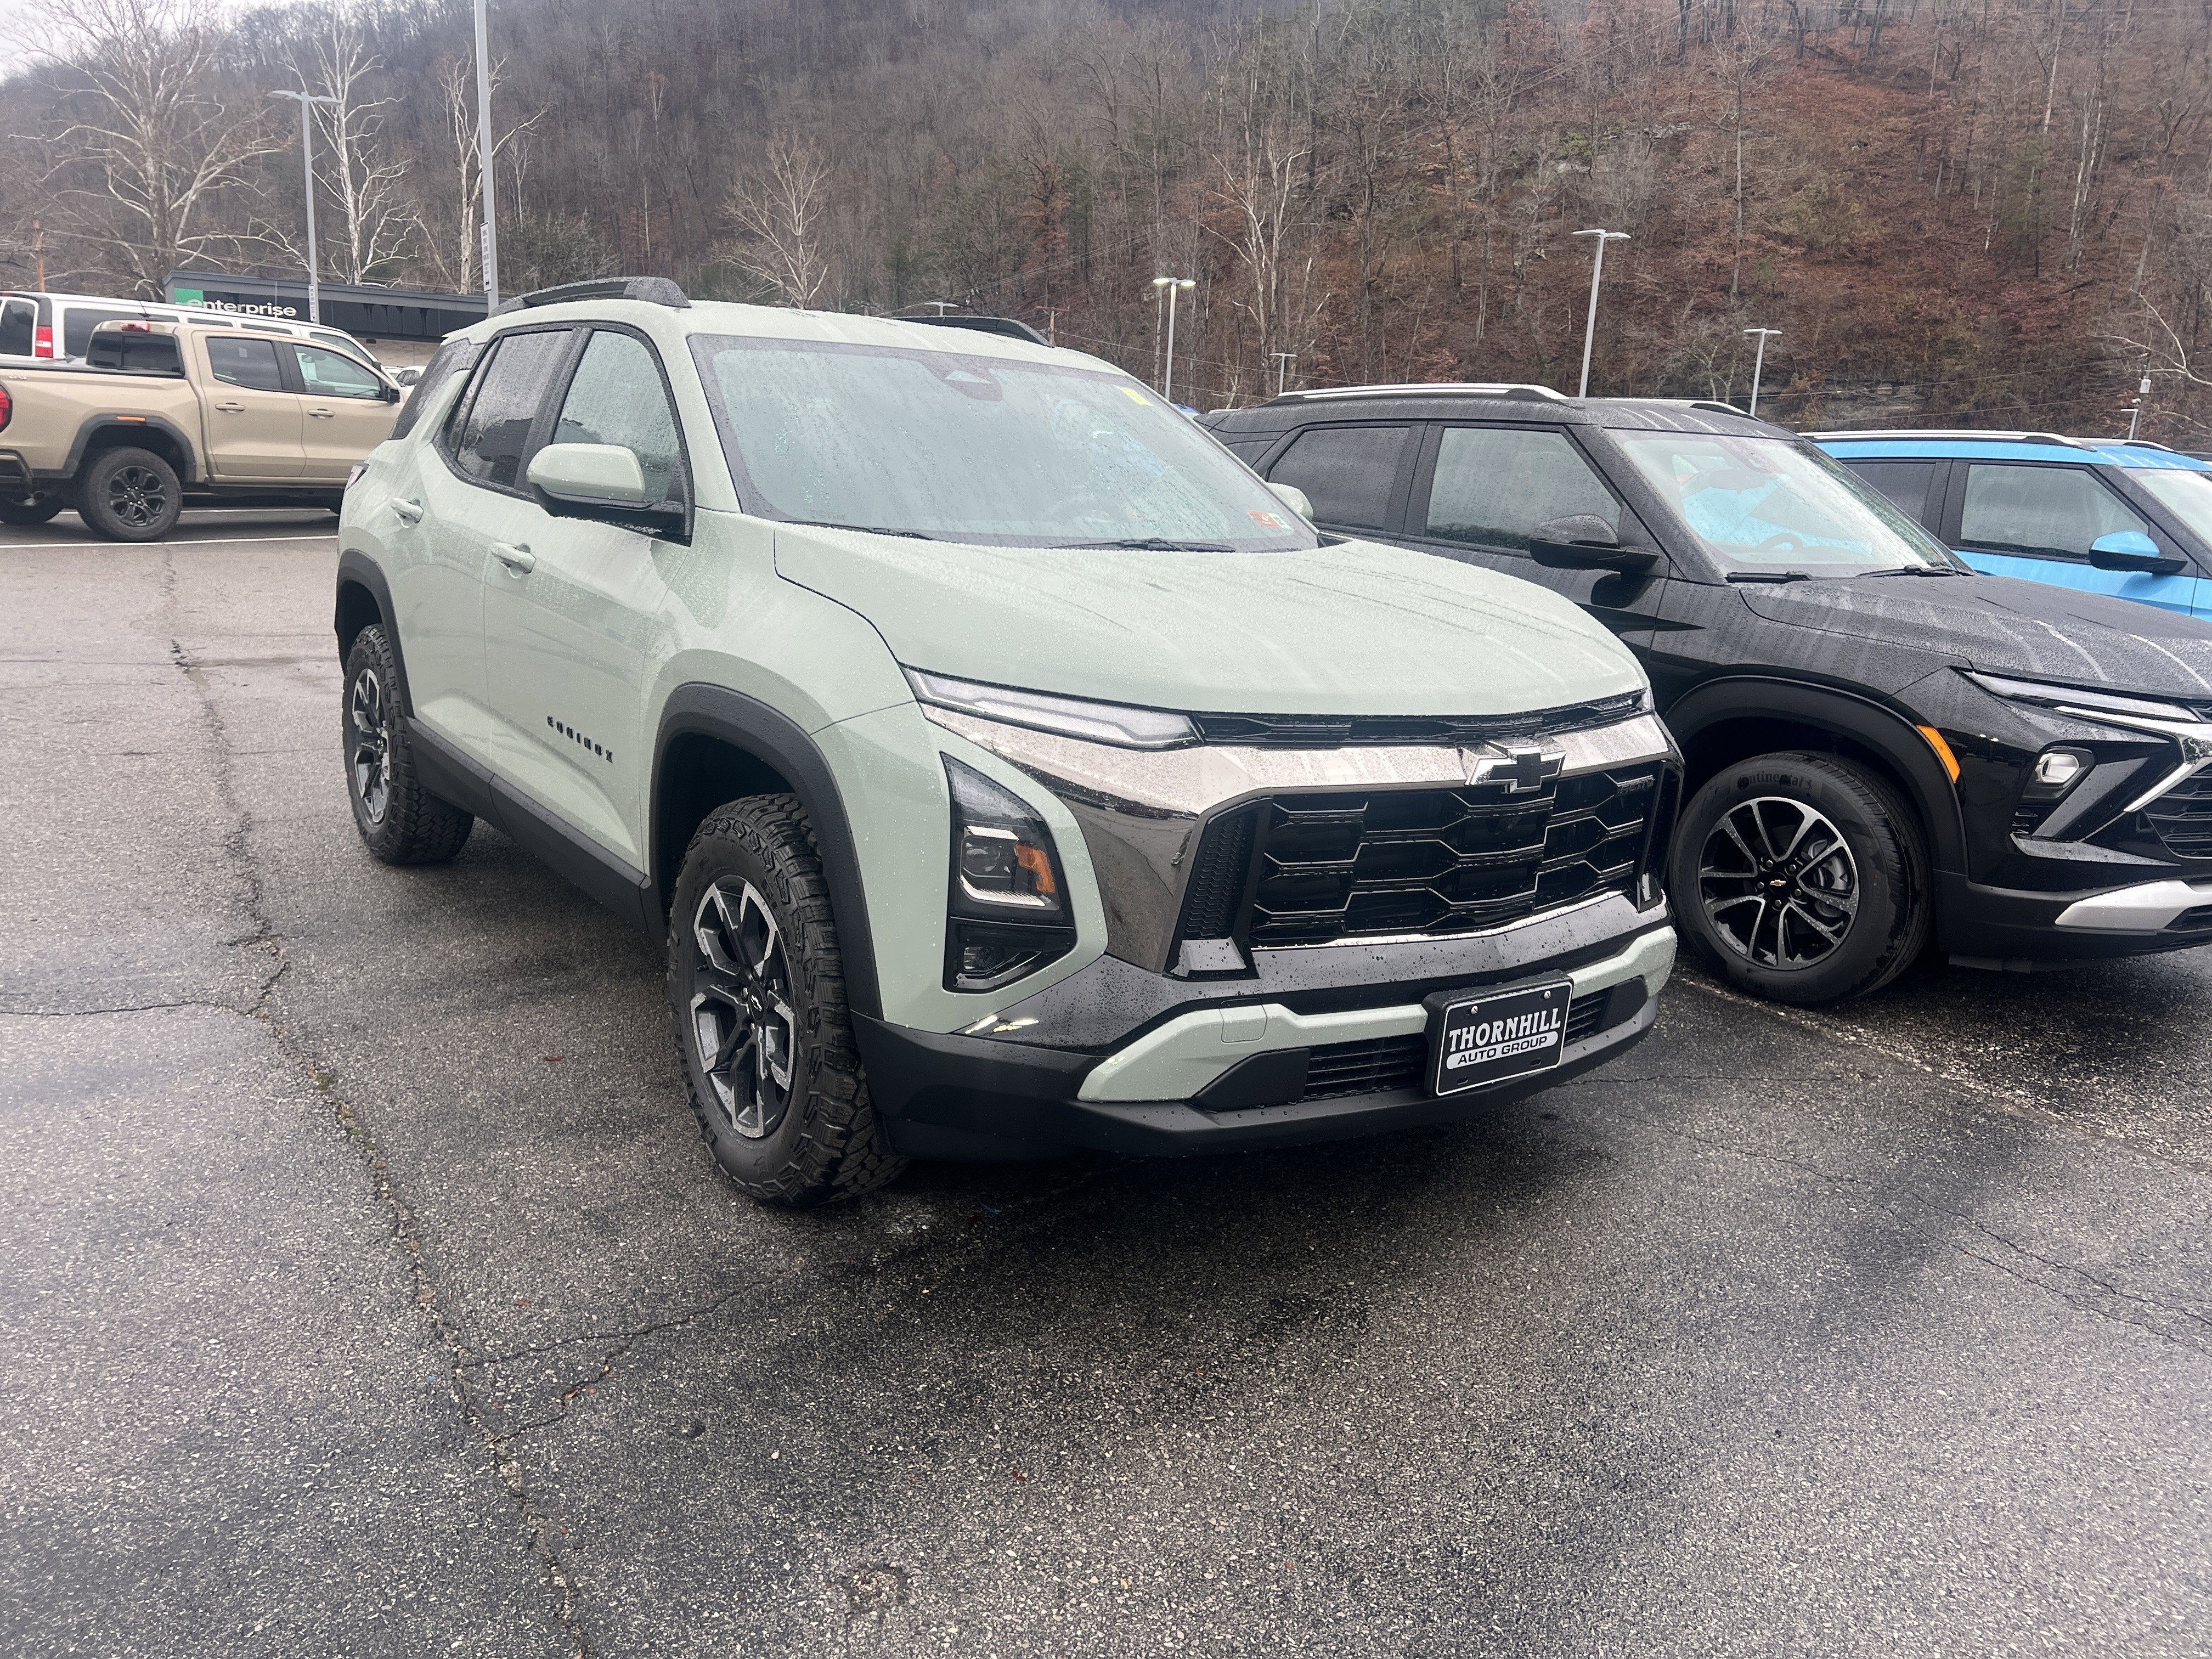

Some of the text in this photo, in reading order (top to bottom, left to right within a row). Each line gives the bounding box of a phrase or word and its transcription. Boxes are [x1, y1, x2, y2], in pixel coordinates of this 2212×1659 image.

[187, 298, 297, 317] enterprise
[547, 715, 613, 763] EQUINOX
[1737, 771, 1804, 790] ntineal
[1449, 1008, 1561, 1052] THORNHILL
[1458, 1036, 1547, 1065] AUTO GROUP
